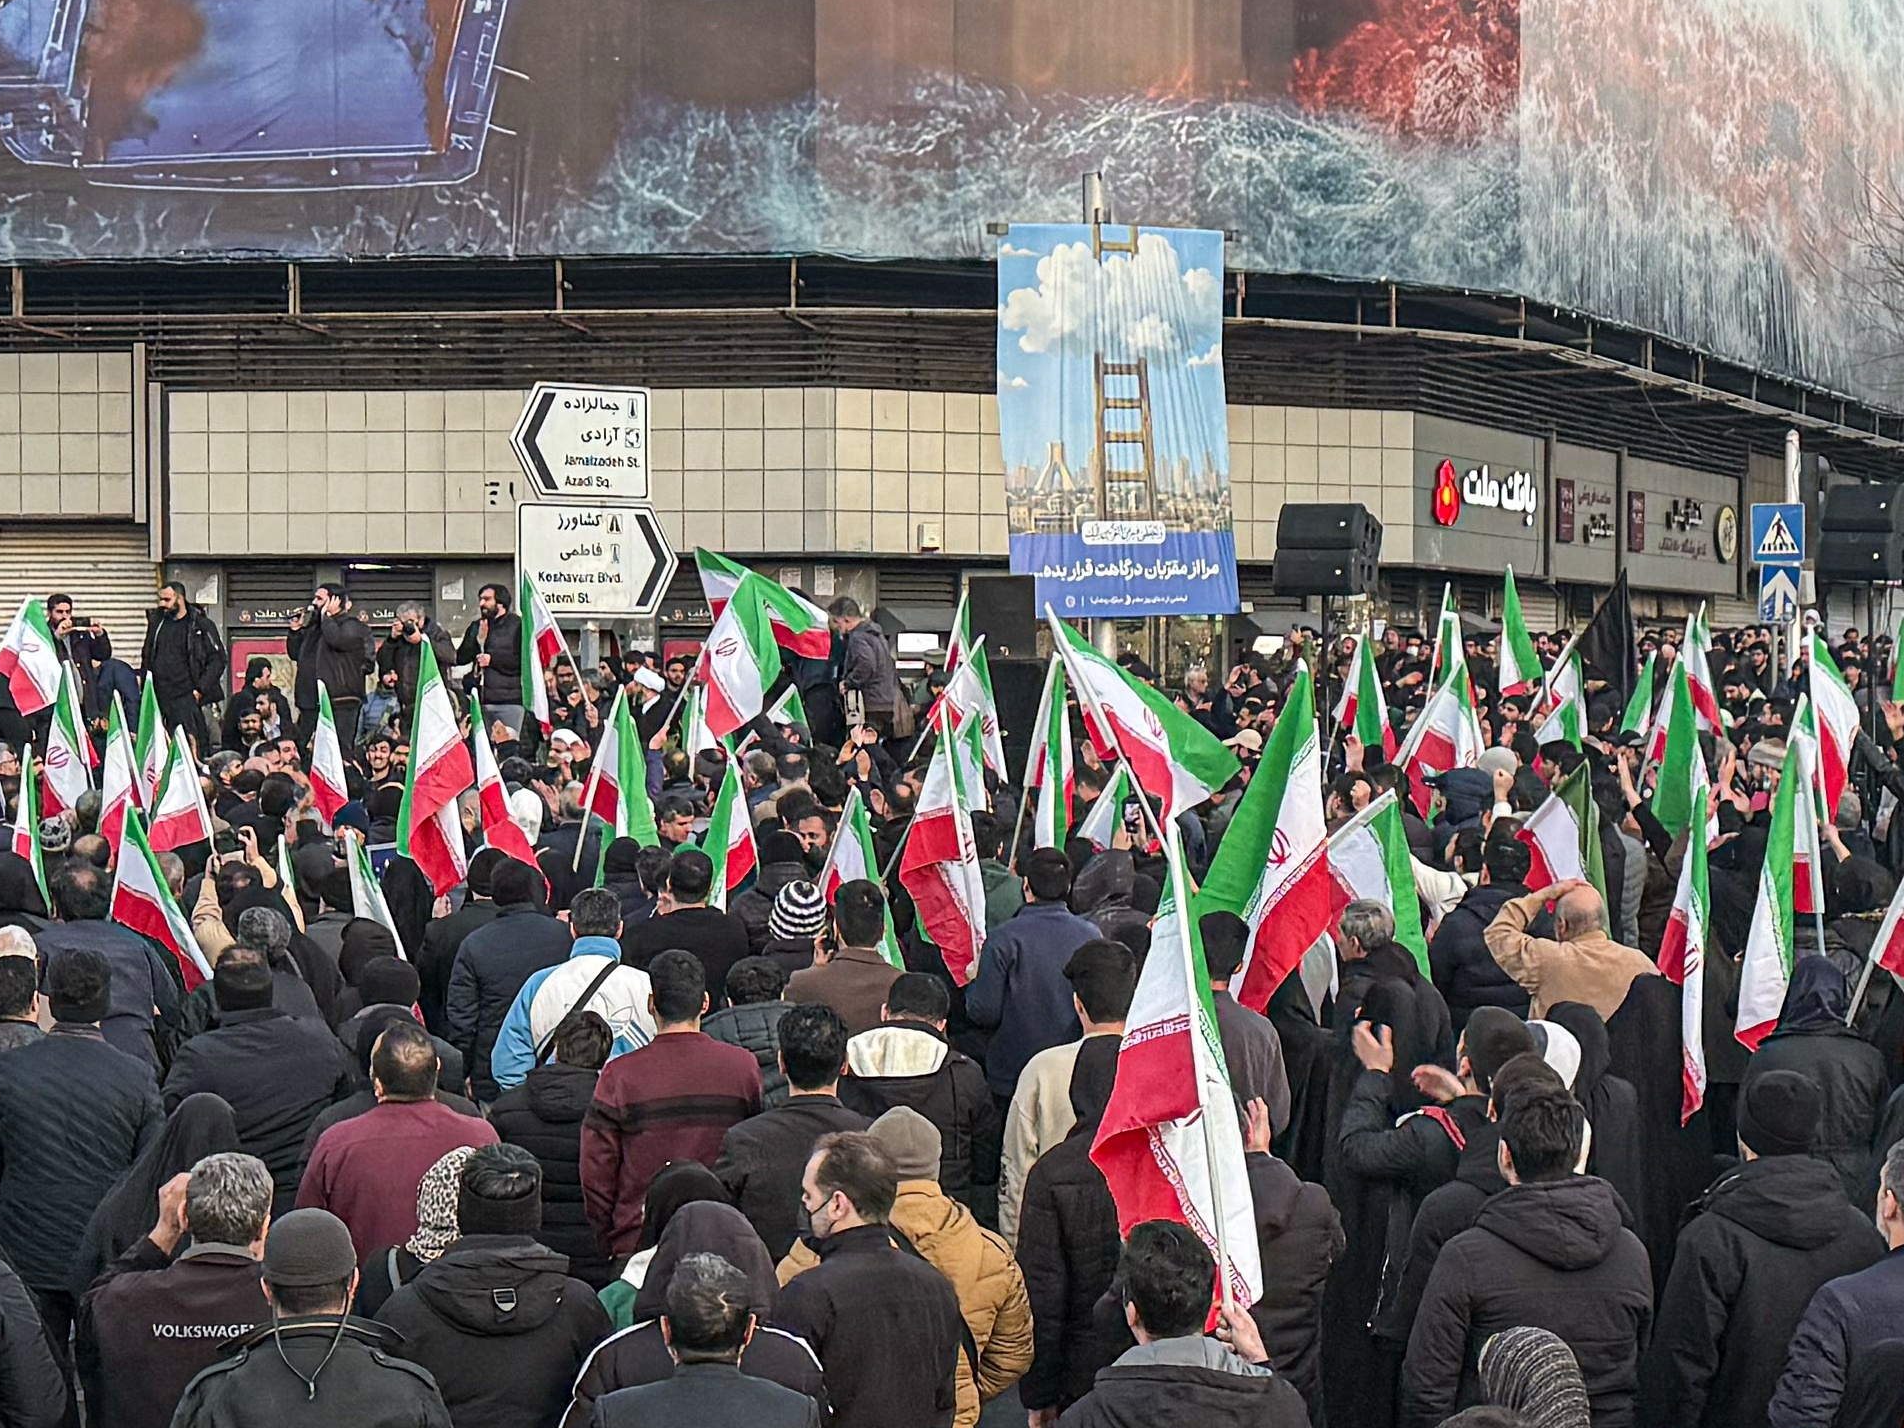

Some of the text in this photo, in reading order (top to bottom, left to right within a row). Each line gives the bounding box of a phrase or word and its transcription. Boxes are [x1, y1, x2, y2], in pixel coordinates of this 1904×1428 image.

[564, 396, 620, 415] جمالزاده
[581, 427, 620, 447] آزادی
[564, 475, 612, 489] Azadi Sq.
[1463, 464, 1500, 508] ملت
[1501, 470, 1536, 527] بانک
[557, 512, 603, 531] کشاورز
[559, 543, 603, 561] فاطمی
[1067, 557, 1094, 581] قرار
[1095, 557, 1144, 581] درگاهت
[1187, 558, 1201, 580] از
[1201, 558, 1220, 580] مرا
[542, 592, 575, 603] atemi
[152, 1323, 255, 1339] VOLKSWAGE
